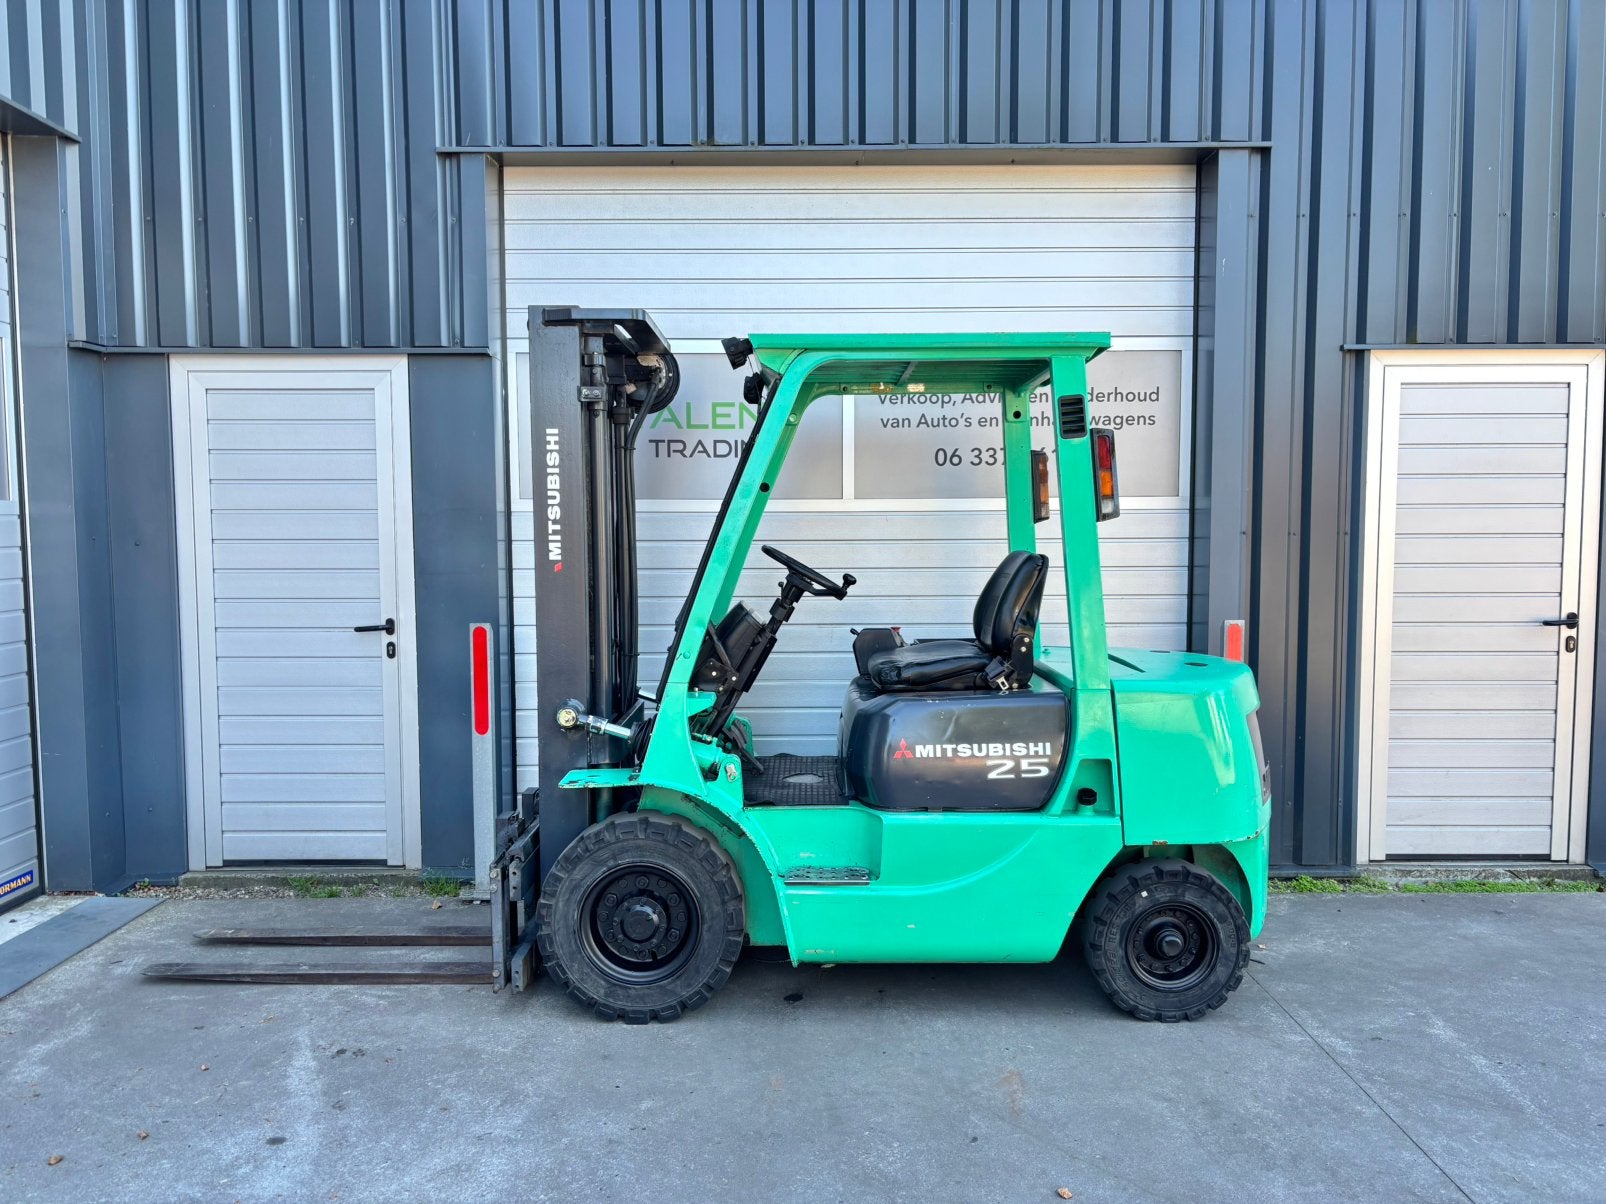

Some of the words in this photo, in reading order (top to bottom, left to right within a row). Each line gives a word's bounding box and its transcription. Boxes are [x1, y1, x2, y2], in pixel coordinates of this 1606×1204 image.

[1028, 391, 1049, 403] en
[1086, 387, 1159, 402] derhoud
[650, 402, 758, 429] ALEN
[880, 418, 911, 428] van
[916, 412, 972, 428] Auto's
[978, 416, 999, 427] en
[934, 447, 963, 466] 06
[546, 428, 562, 561] MITSUBISHI
[915, 742, 1052, 758] MITSUBISHI
[985, 758, 1049, 779] 25
[0, 874, 31, 895] ORMANN
